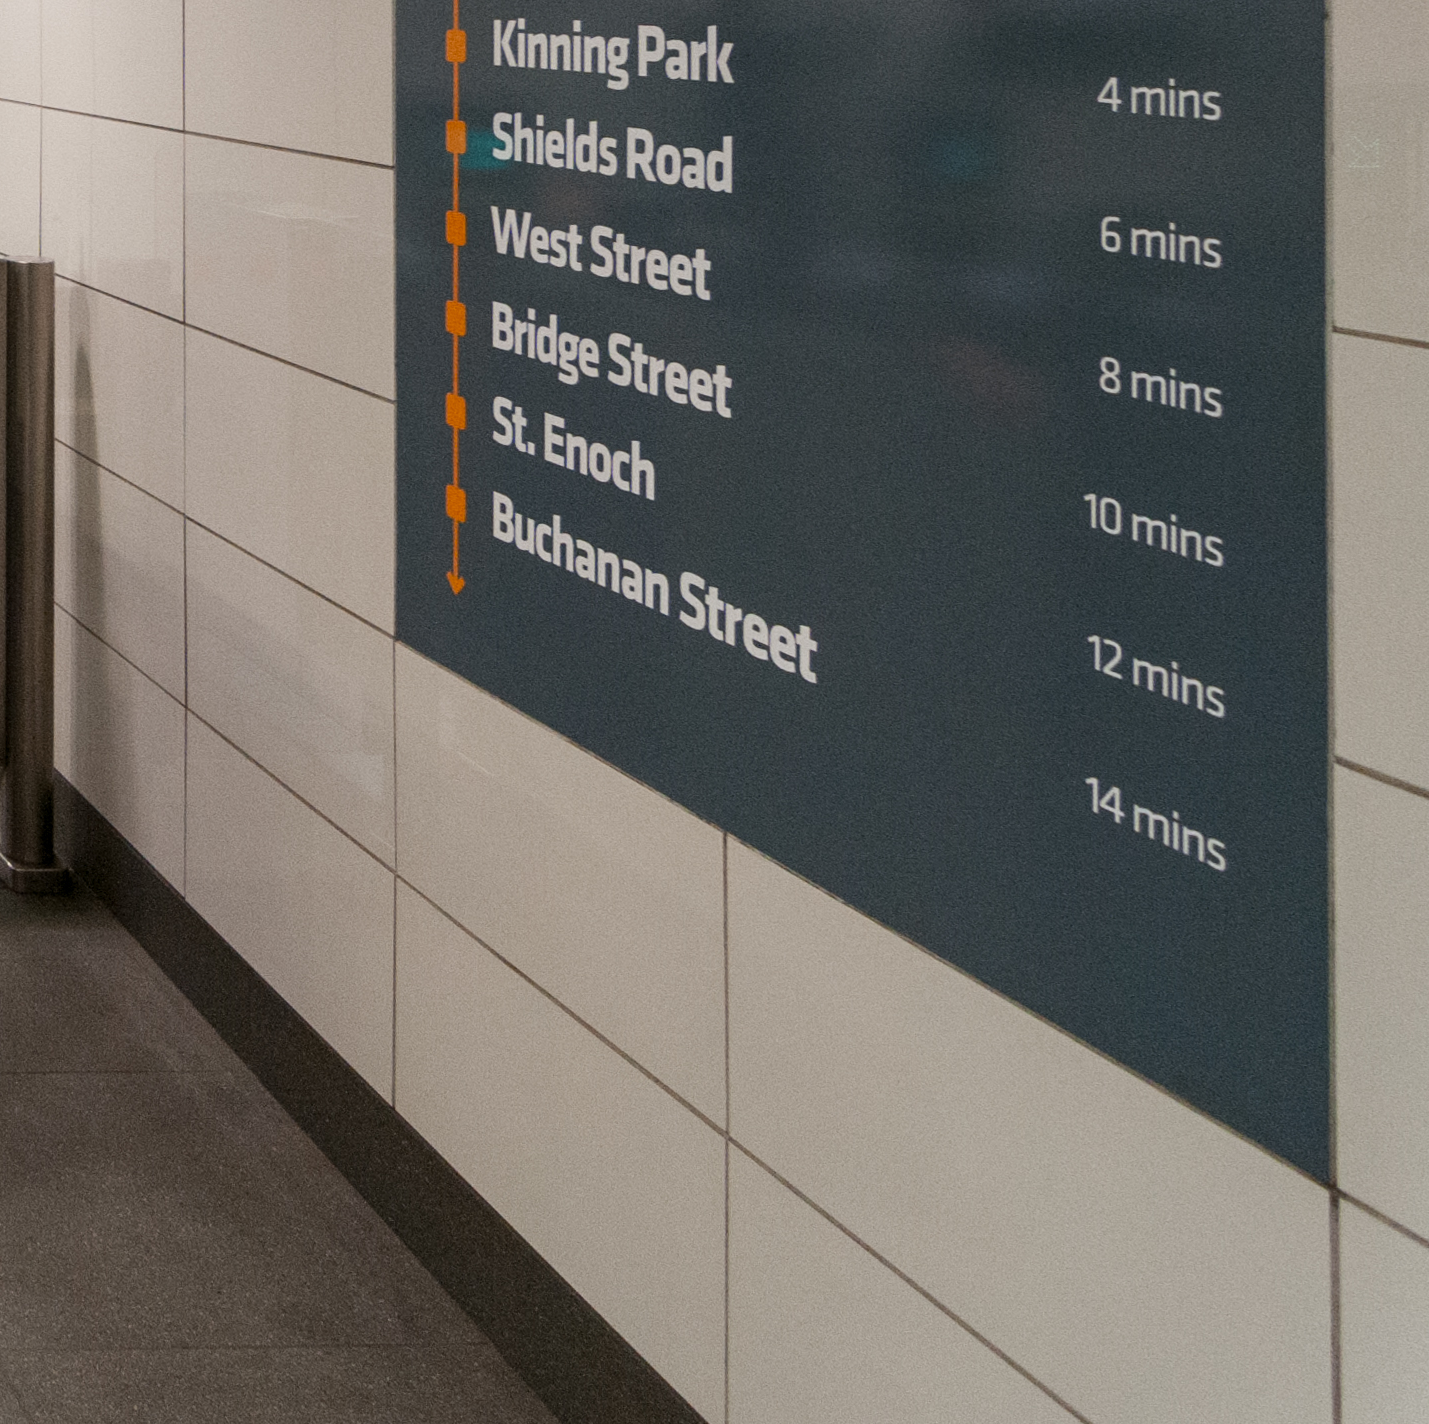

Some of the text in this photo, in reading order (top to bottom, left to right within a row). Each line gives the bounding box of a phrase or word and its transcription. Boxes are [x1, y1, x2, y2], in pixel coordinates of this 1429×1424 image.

[493, 18, 734, 90] Kinning Park
[1097, 77, 1222, 121] 4 mins
[492, 112, 733, 193] Shields Road
[491, 205, 711, 300] West Street
[1100, 216, 1222, 268] 6 mins
[492, 301, 732, 418] Bridge Street
[1099, 357, 1223, 418] 8 mins
[492, 396, 655, 501] St. Enoch
[1083, 493, 1224, 567] 10 mins
[493, 491, 818, 684] Buchanan Street
[1087, 635, 1225, 718] 12 mins
[1085, 777, 1226, 872] 14 mins
